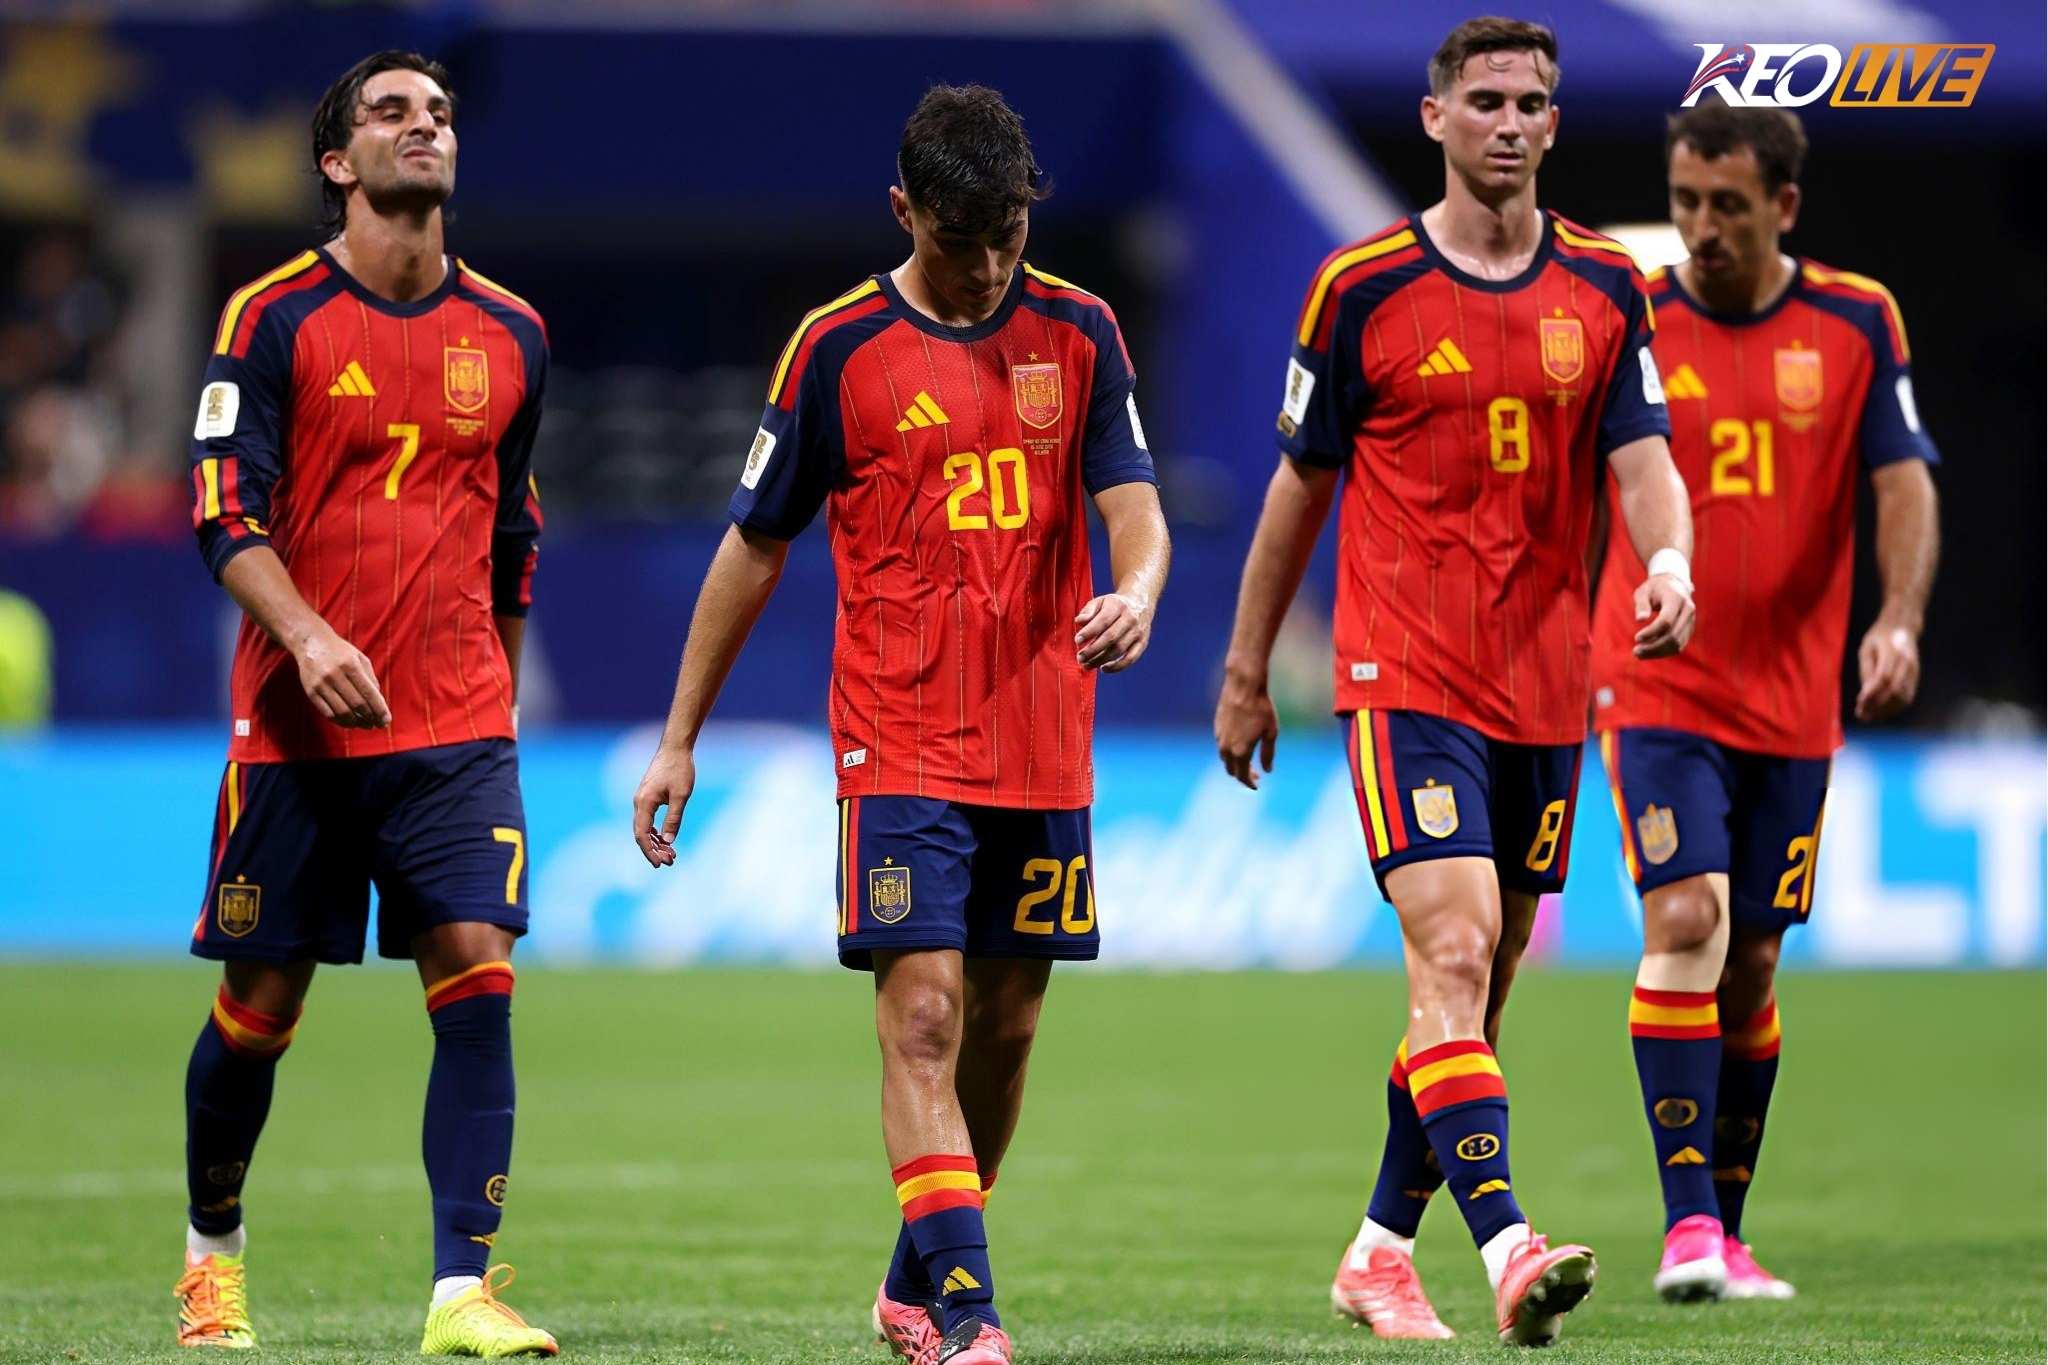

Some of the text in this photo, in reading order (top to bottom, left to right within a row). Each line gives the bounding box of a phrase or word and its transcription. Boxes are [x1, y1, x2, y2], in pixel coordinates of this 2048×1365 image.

[384, 423, 420, 500] 7
[1488, 396, 1530, 473] 8
[1710, 418, 1774, 496] 21
[943, 447, 1030, 532] 20
[492, 827, 524, 905] 7
[1525, 799, 1566, 872] 8
[1013, 854, 1095, 935] 20
